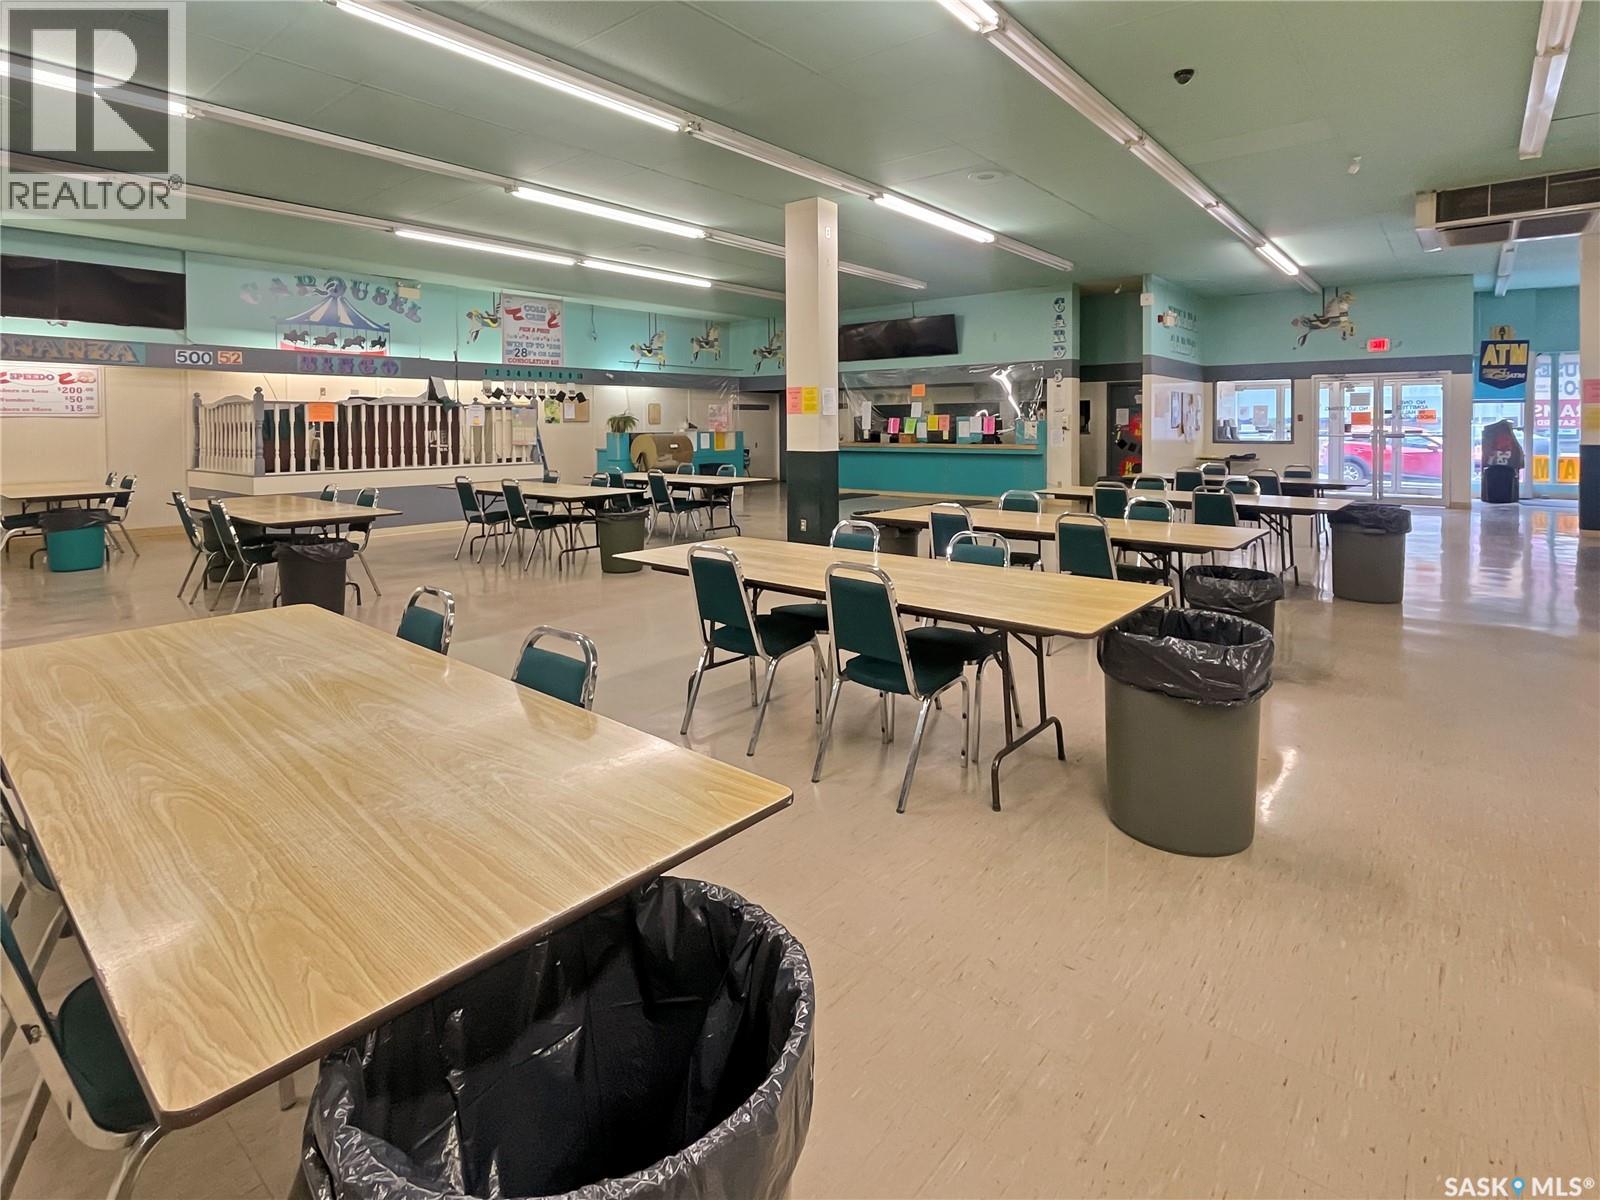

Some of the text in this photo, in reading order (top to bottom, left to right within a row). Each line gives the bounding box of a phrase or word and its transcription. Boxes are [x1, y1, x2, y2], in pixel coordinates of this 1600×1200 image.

[176, 350, 243, 365] 500 52
[514, 347, 528, 358] 28
[1481, 343, 1528, 366] ATM
[9, 373, 55, 381] SPEEDO
